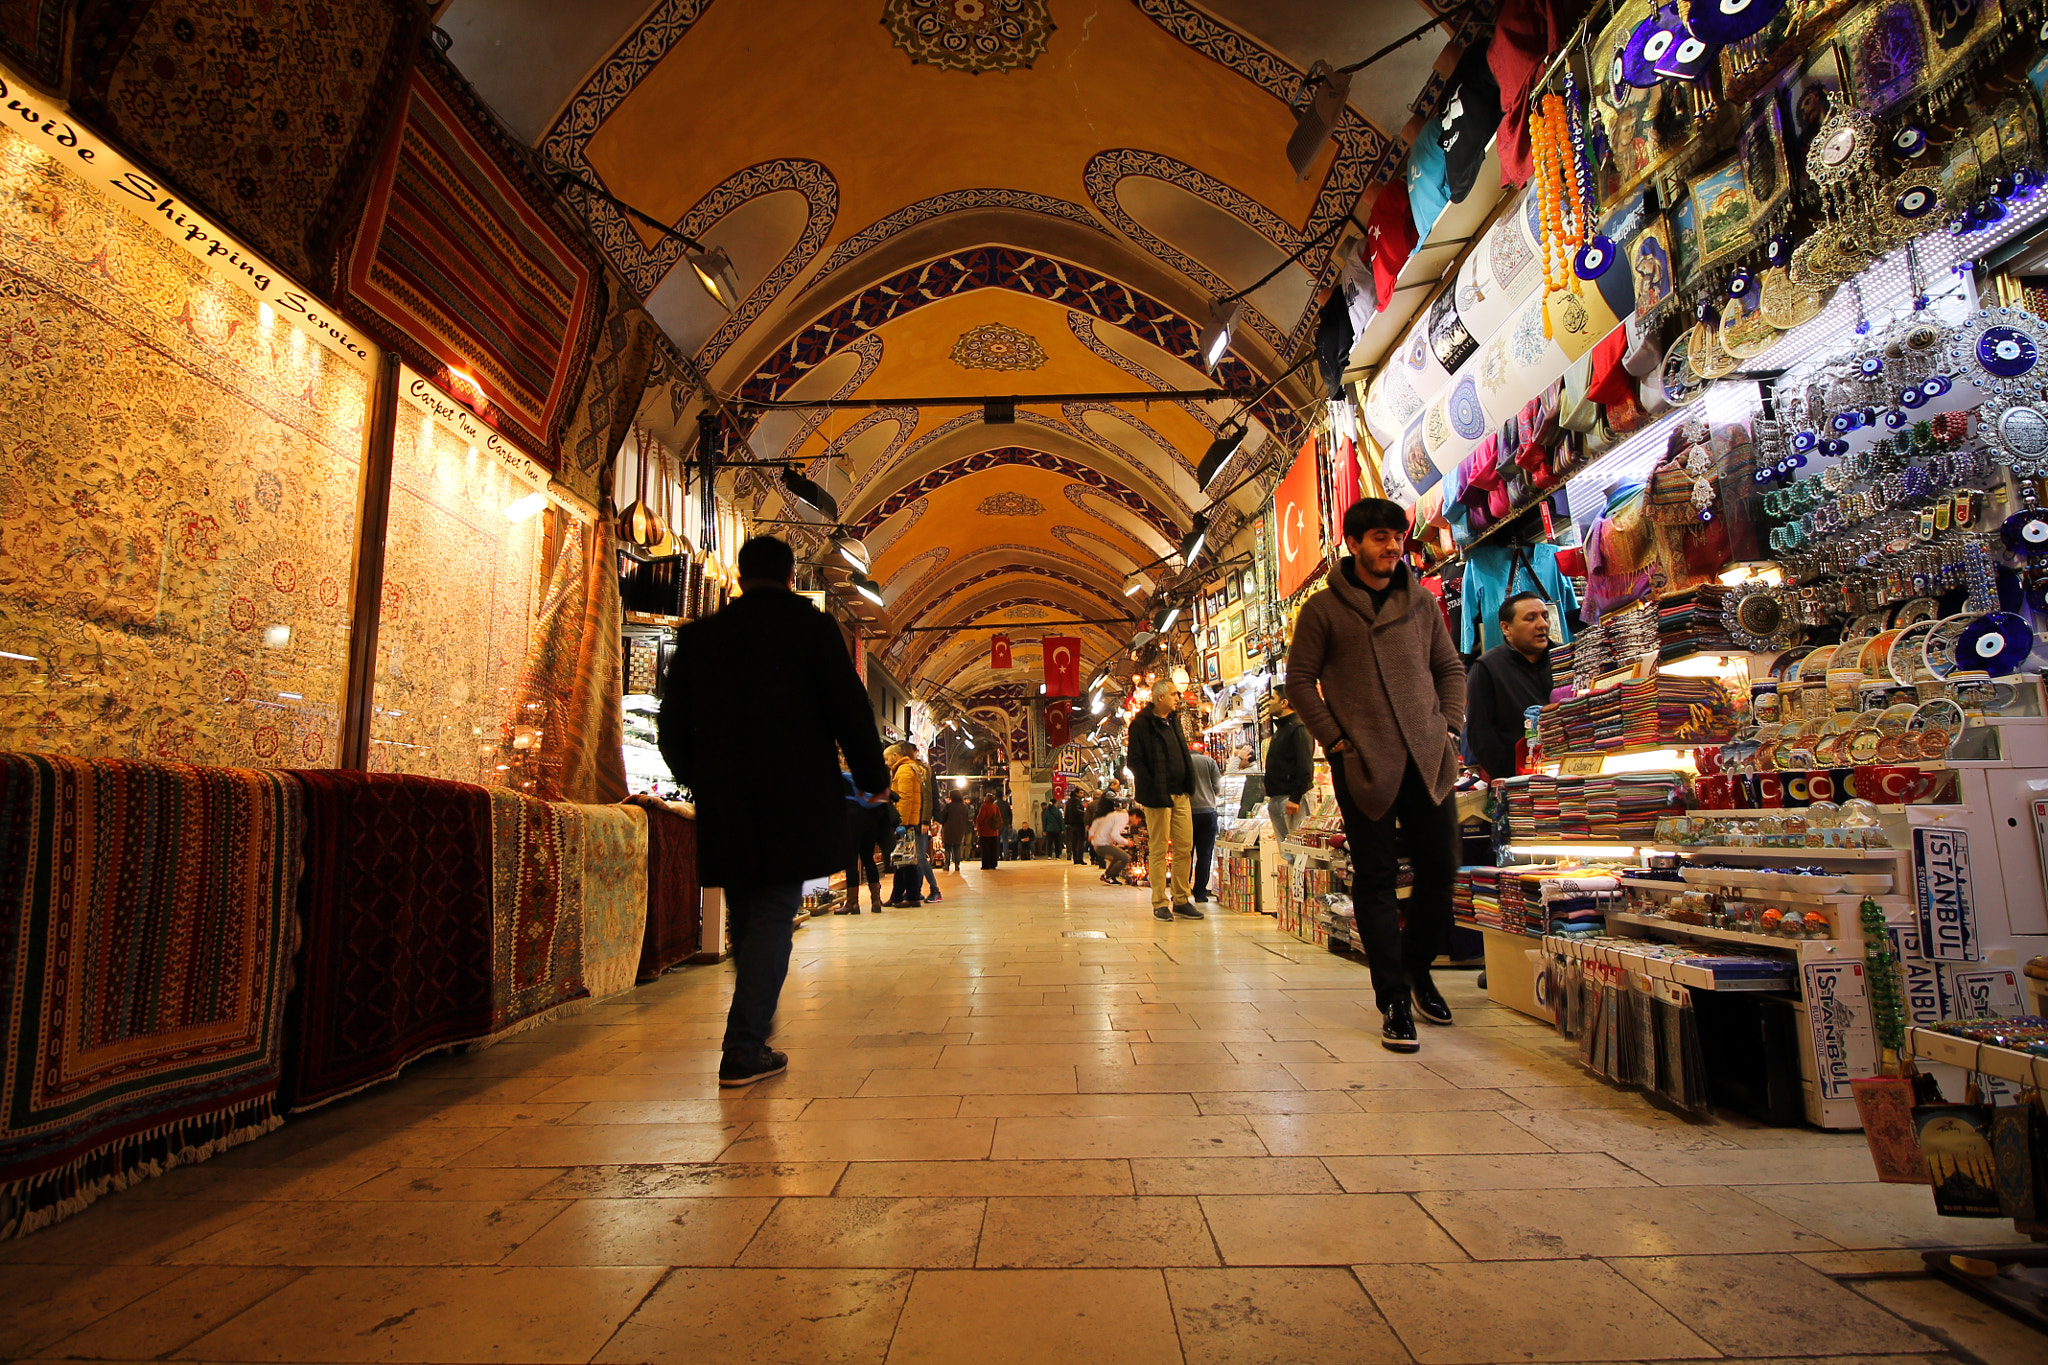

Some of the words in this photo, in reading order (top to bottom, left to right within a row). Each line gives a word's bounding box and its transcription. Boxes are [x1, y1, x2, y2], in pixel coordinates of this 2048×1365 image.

[109, 173, 271, 292] Shipping
[274, 291, 367, 361] Service
[410, 379, 454, 421] Carpet
[458, 412, 477, 438] Inn
[487, 434, 521, 468] Carpet
[524, 460, 539, 482] Inn
[1917, 866, 1927, 893] SEVEN
[1920, 895, 1930, 920] HILLS
[1815, 1028, 1824, 1057] MOSQUE
